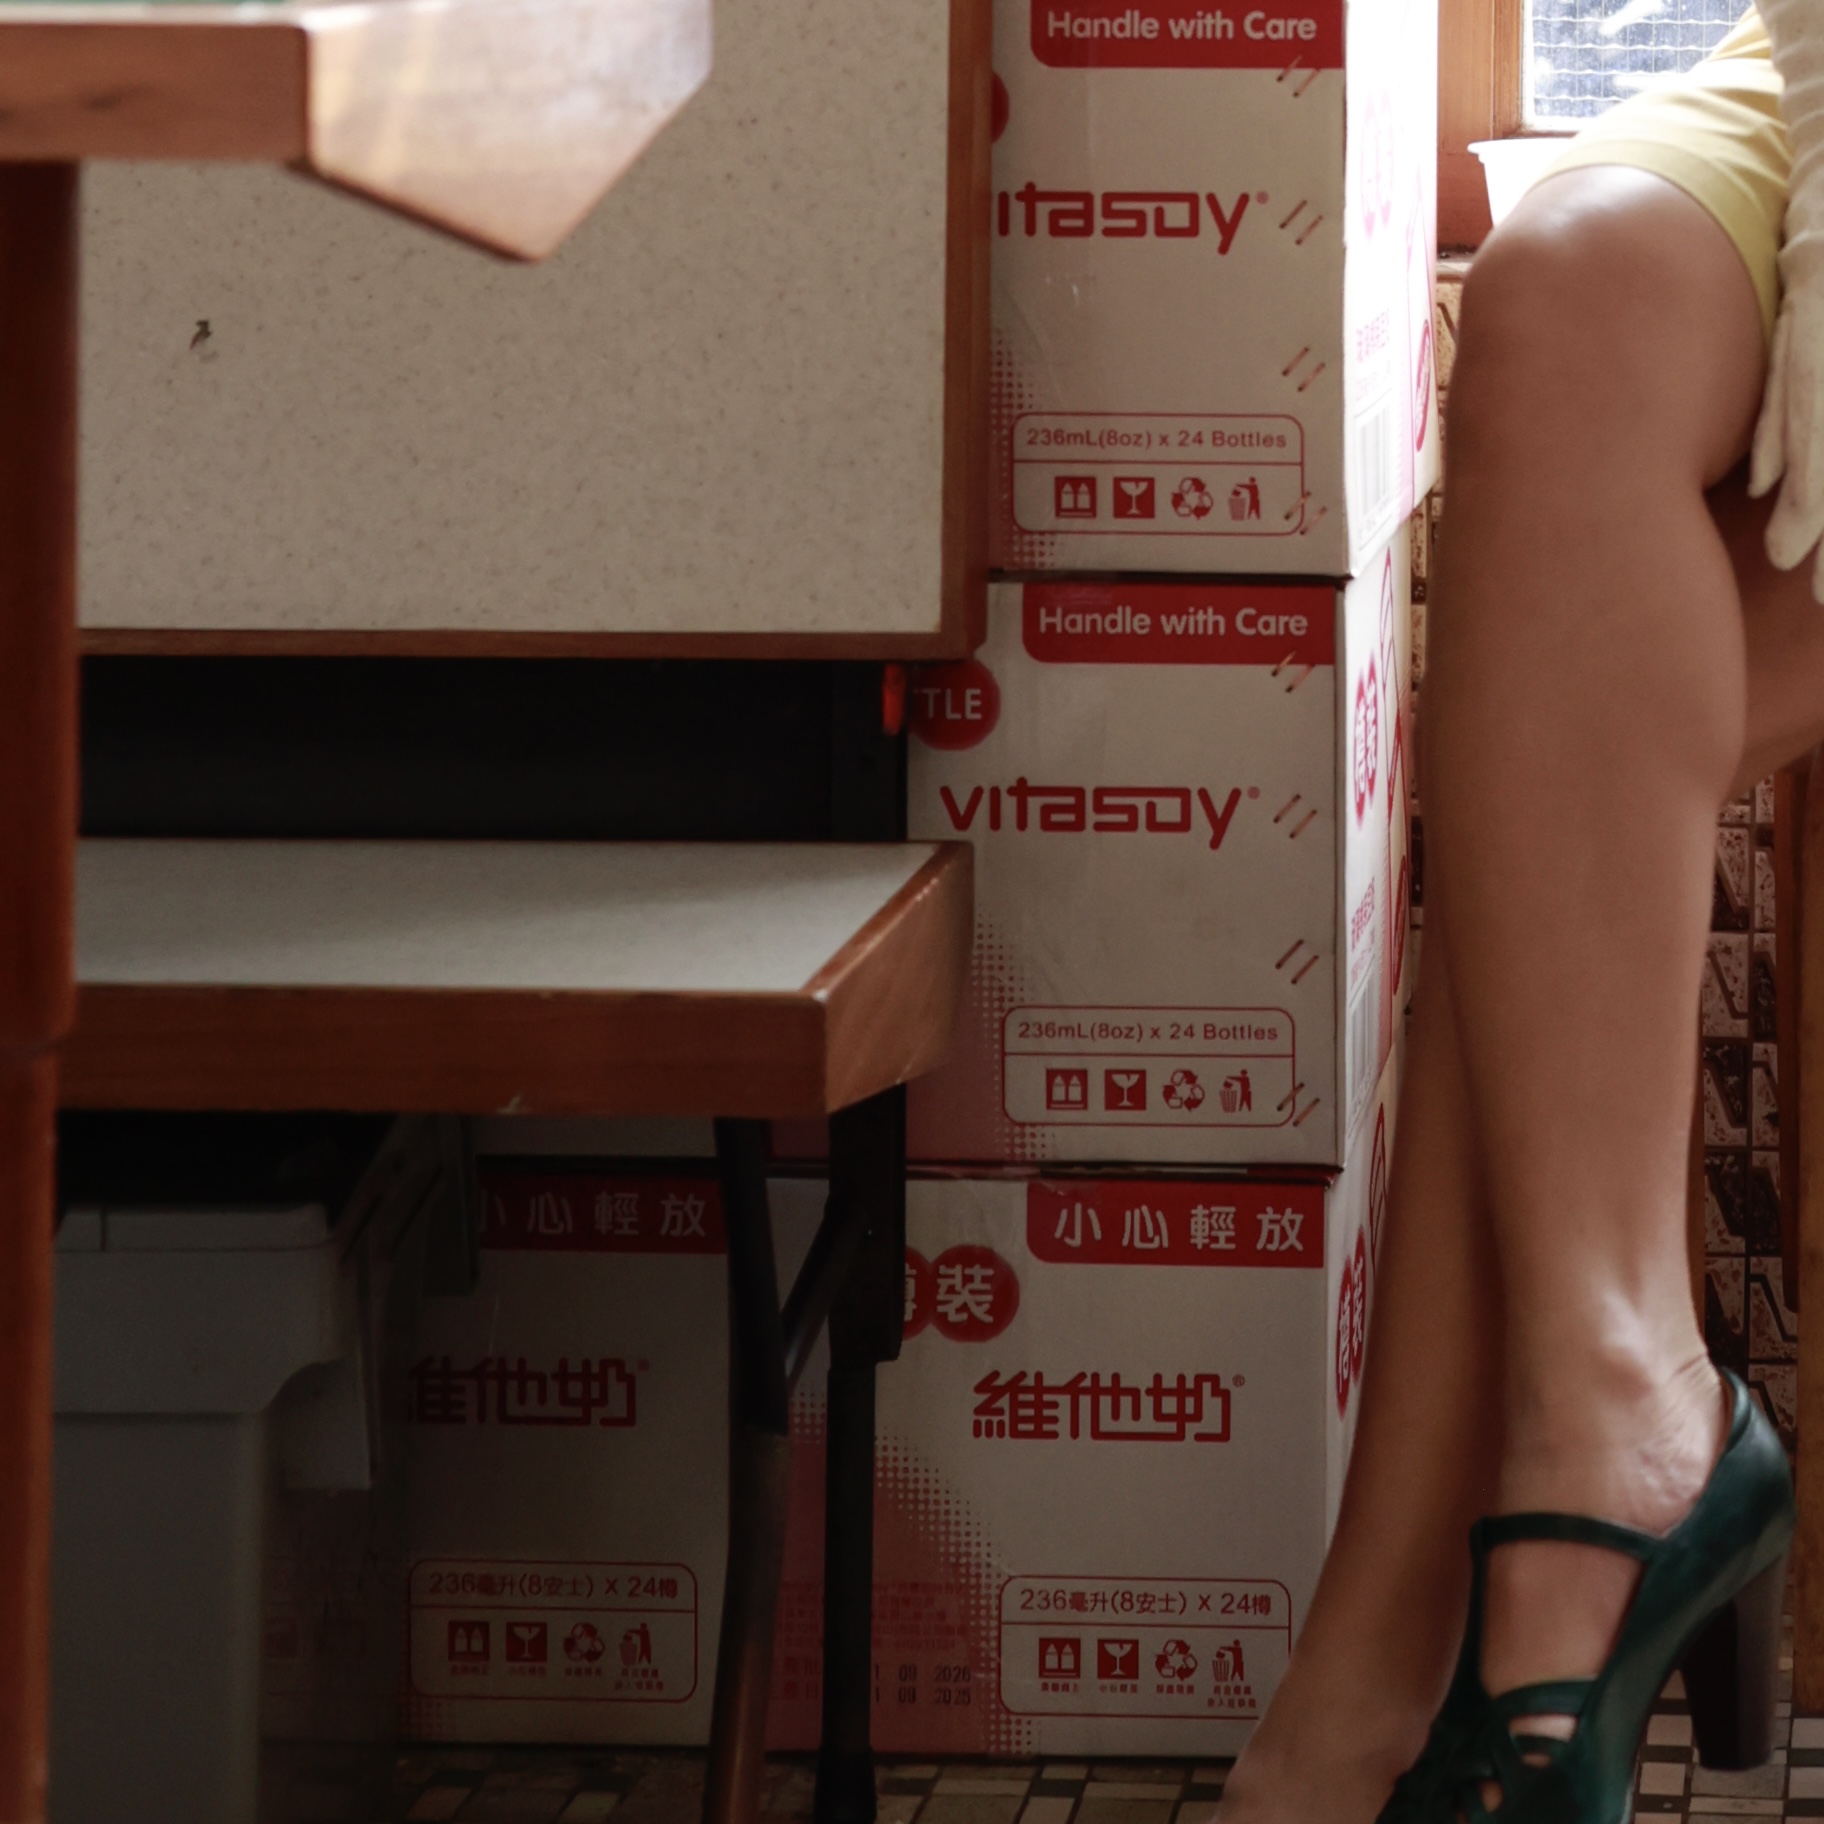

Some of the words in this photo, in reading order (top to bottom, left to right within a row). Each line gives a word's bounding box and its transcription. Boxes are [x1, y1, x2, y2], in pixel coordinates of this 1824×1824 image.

[1047, 10, 1158, 40] Handle
[1168, 10, 1234, 40] with
[1243, 11, 1318, 41] Care
[996, 180, 1250, 256] itasoy
[1026, 429, 1152, 449] 236mL(8oz)
[1177, 430, 1204, 448] 24
[1212, 430, 1287, 449] Bottles
[1038, 607, 1151, 637] Handle
[1160, 607, 1226, 636] with
[1235, 608, 1308, 637] Care
[913, 687, 983, 720] TLE
[940, 776, 1242, 851] vitasoy
[1017, 1021, 1144, 1043] 236mL(8oz)
[1168, 1023, 1196, 1040] 24
[1202, 1022, 1279, 1042] Bottles
[1054, 1202, 1304, 1253] 小心輕放
[972, 1369, 1233, 1443] 維他奶
